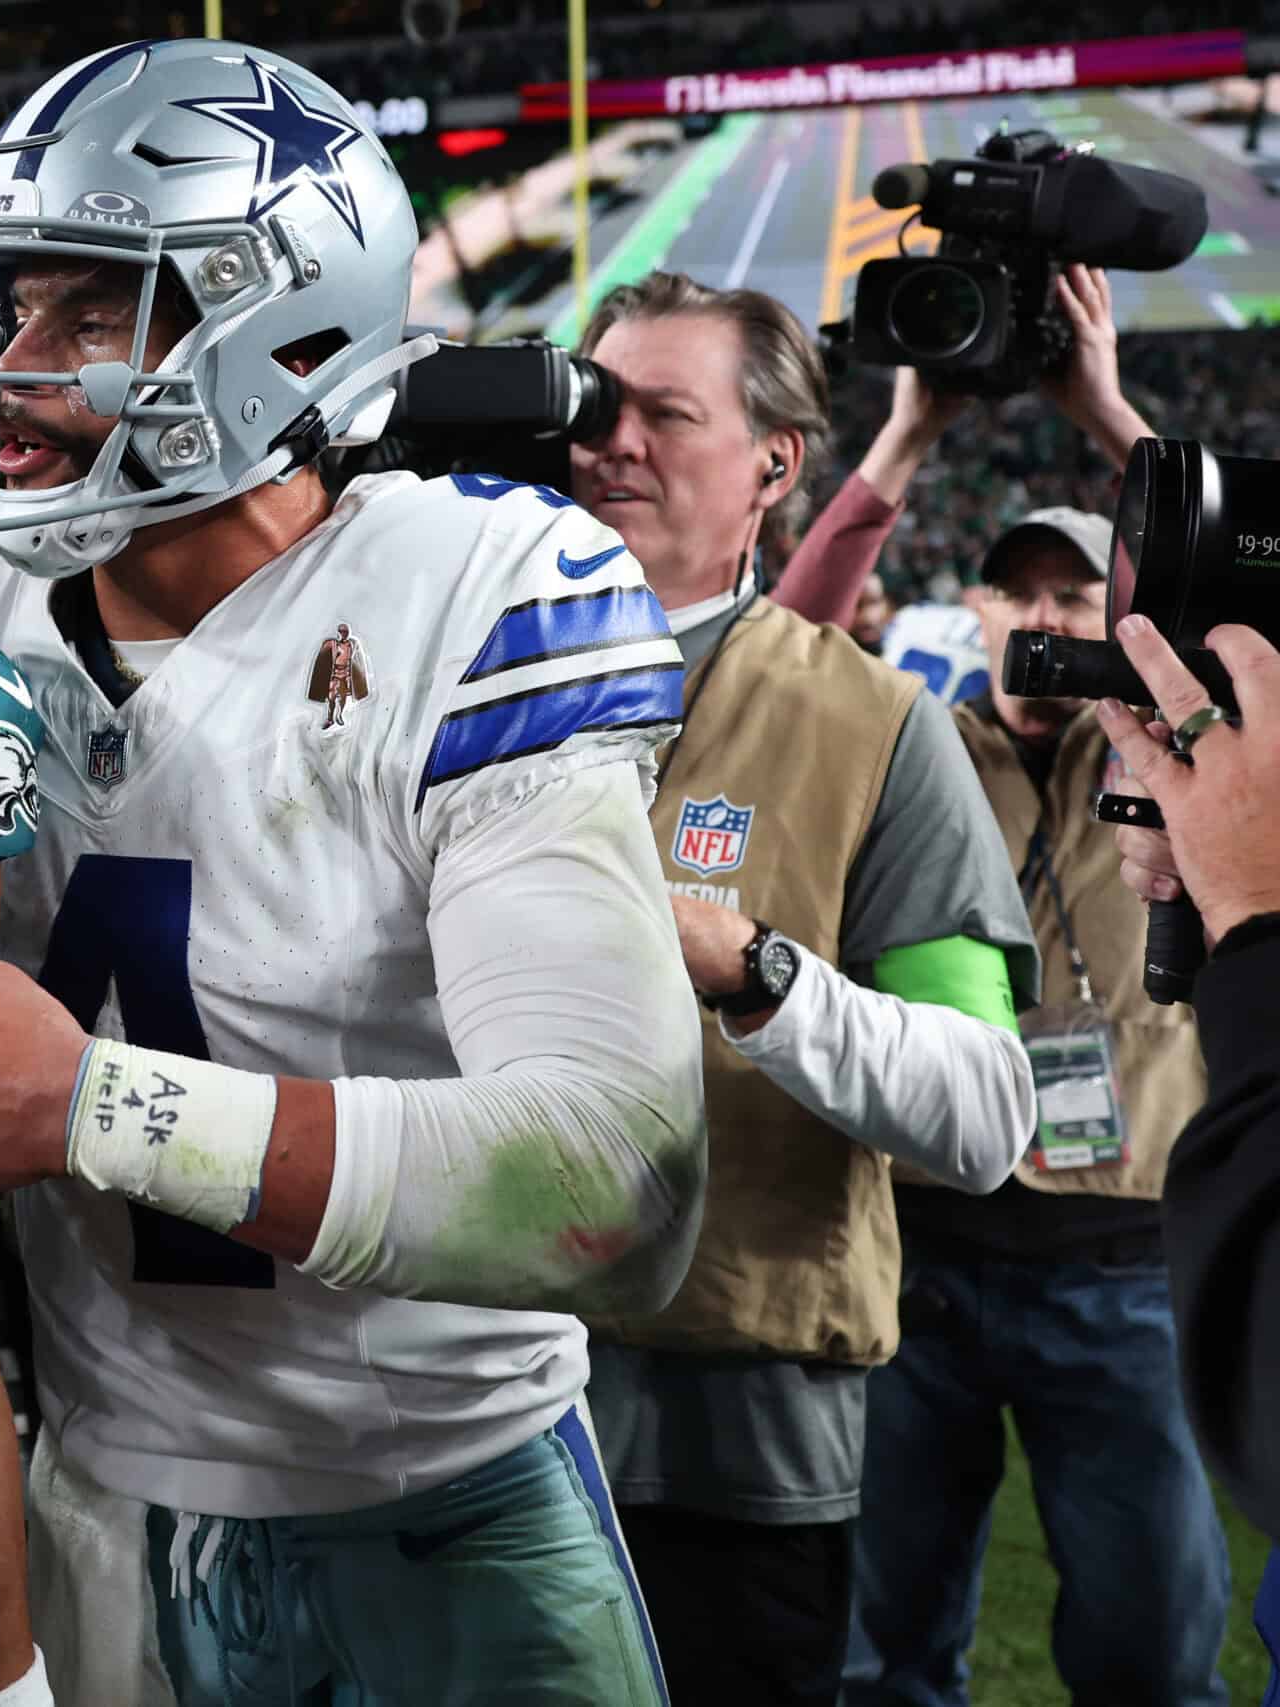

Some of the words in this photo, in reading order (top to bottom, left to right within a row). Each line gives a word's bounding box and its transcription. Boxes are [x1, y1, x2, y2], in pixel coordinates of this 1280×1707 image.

[704, 67, 826, 113] Lincoln
[828, 54, 984, 102] Financial
[985, 47, 1076, 92] Field
[90, 752, 121, 778] NFL
[681, 828, 736, 866] NFL
[120, 1087, 145, 1110] 4
[142, 1071, 188, 1147] ASK
